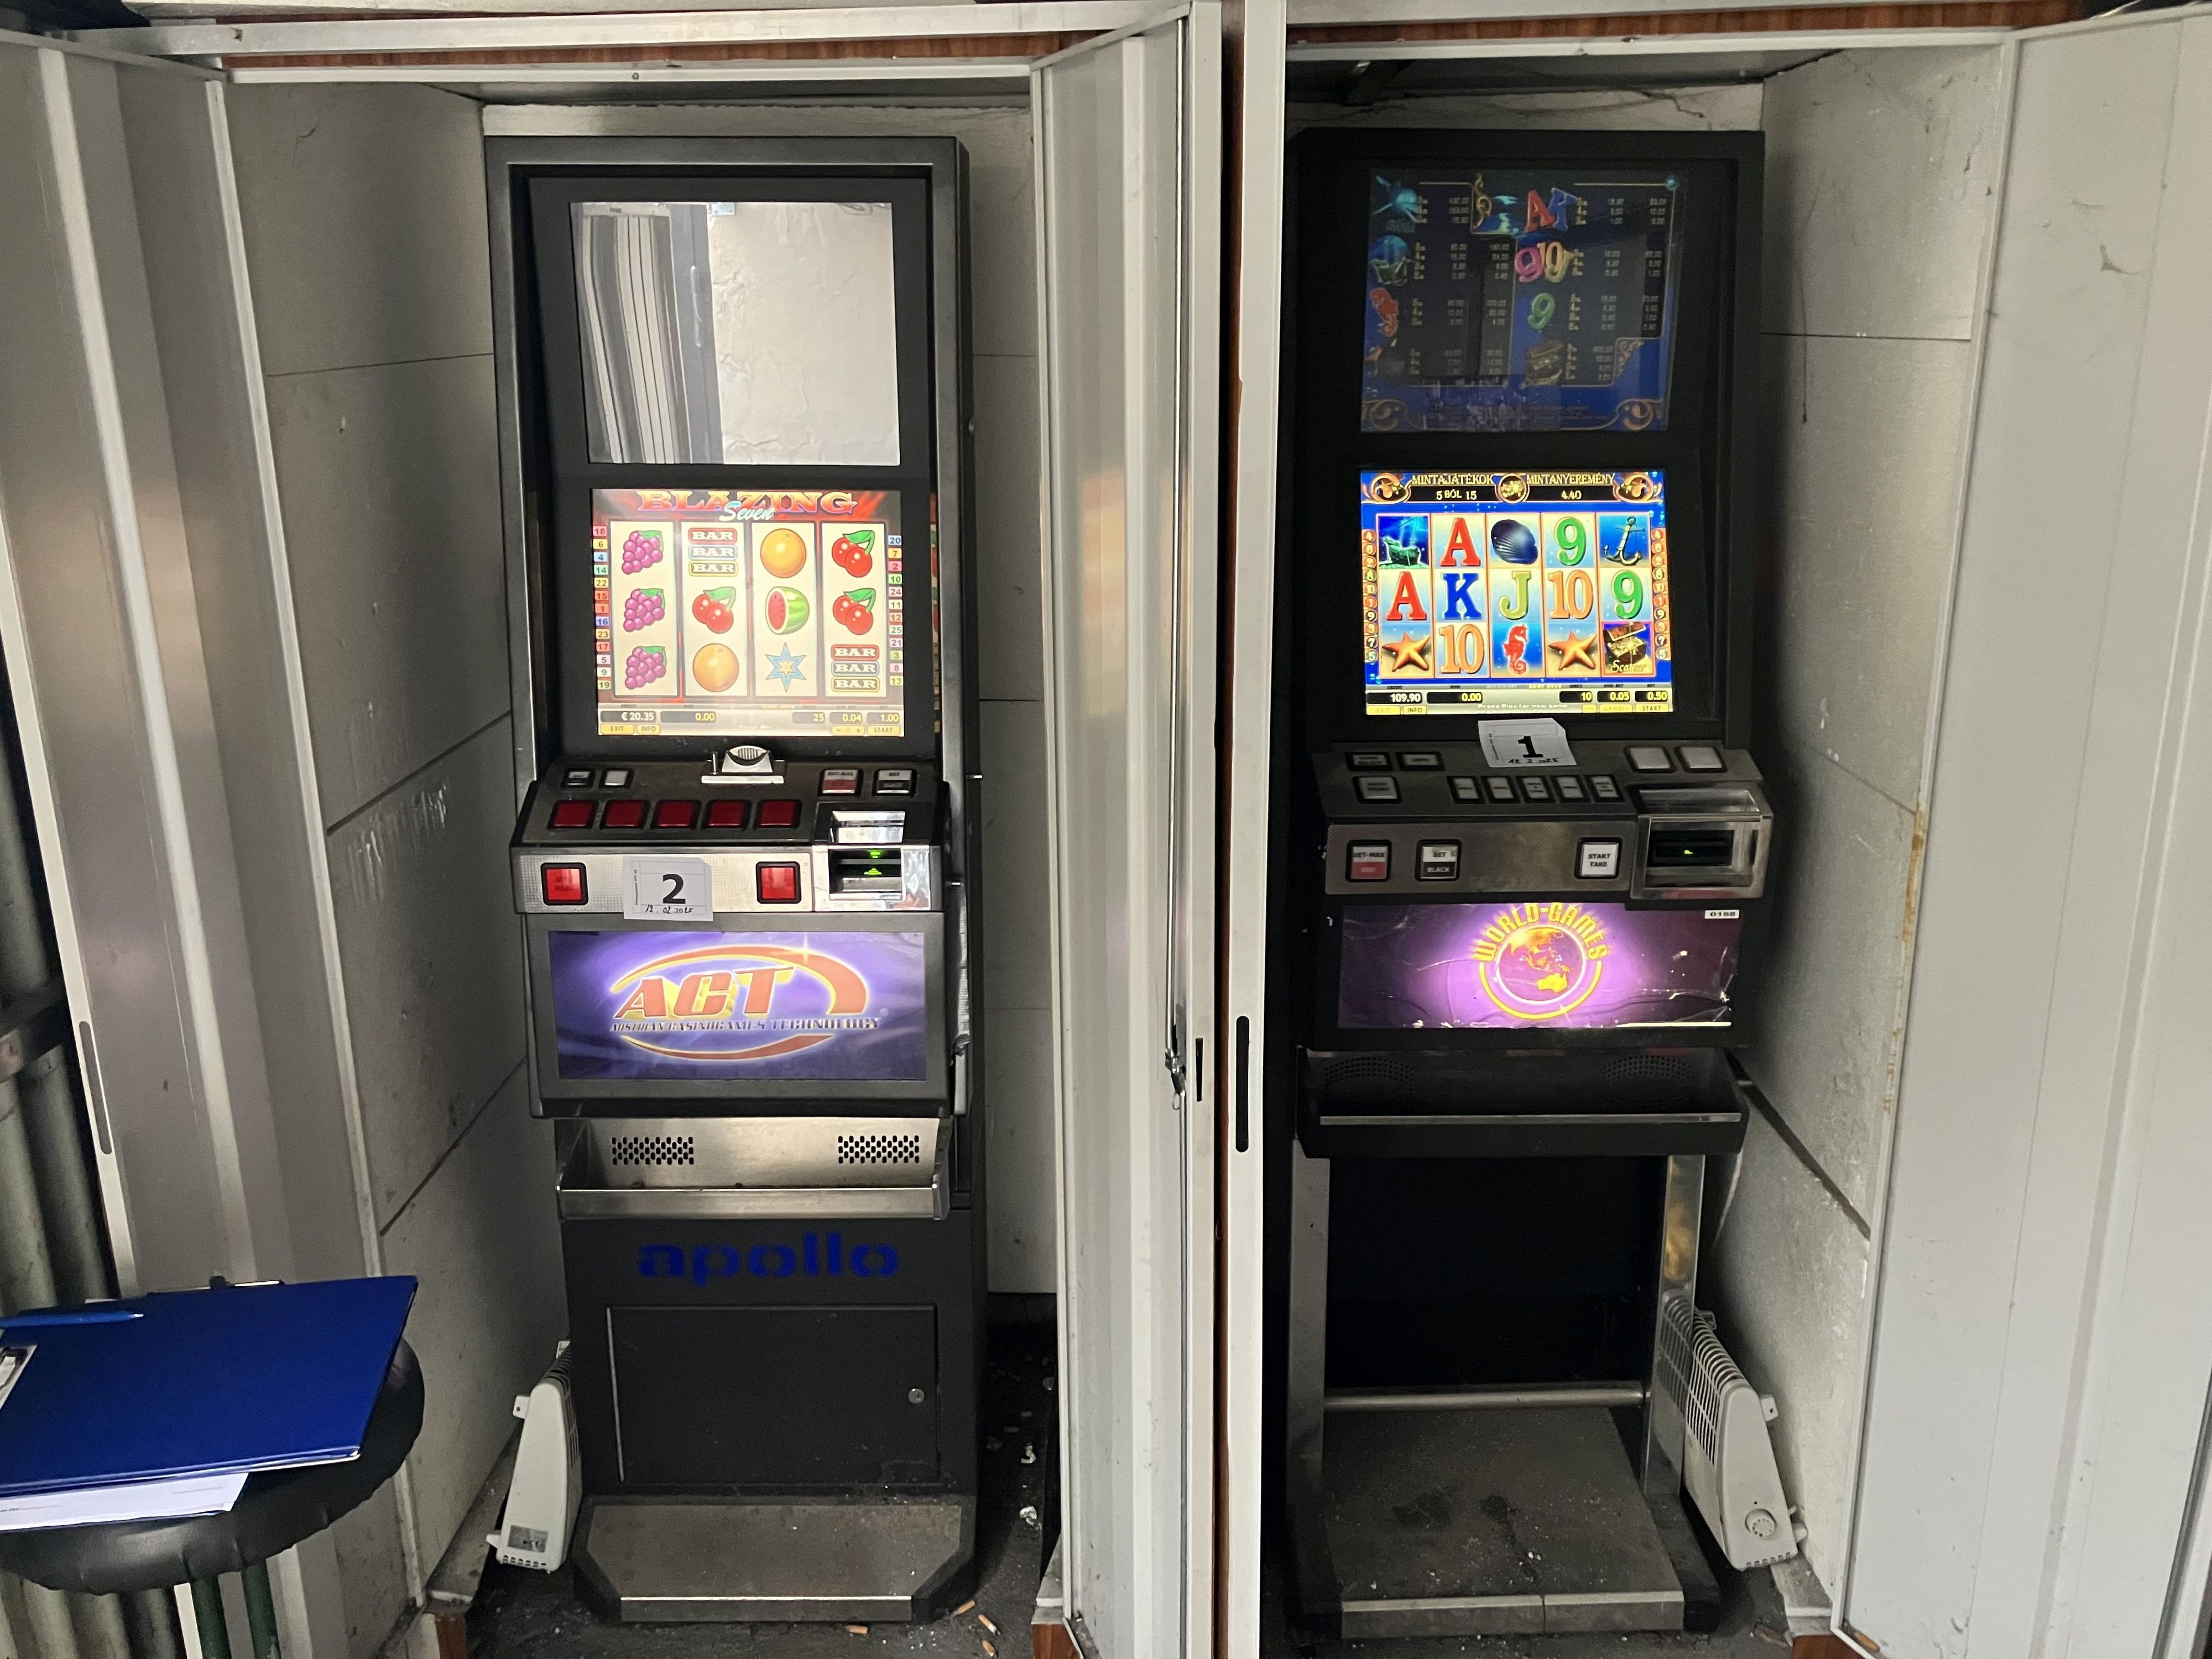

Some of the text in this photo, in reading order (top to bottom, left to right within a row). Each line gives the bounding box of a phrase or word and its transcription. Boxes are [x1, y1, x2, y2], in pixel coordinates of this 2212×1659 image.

[1527, 293, 1556, 330] 9
[1412, 473, 1494, 485] MINTAJÁTÉKOK
[1526, 473, 1616, 484] MINTANYEREMÉNY
[1436, 489, 1477, 500] 5 BÓL 15
[1561, 490, 1582, 499] 4.40
[636, 491, 858, 514] BLAZING
[719, 501, 774, 521] Seven
[691, 531, 734, 540] BAR
[1439, 517, 1481, 567] A
[1554, 517, 1586, 566] 9
[692, 547, 734, 556] BAR
[693, 564, 734, 572] BAR
[1385, 571, 1427, 620] A
[1442, 573, 1482, 620] K
[1499, 571, 1531, 620] J
[1548, 570, 1593, 619] 10
[1611, 570, 1643, 619] 9
[1368, 612, 1374, 620] 9
[1657, 610, 1663, 619] 9
[1368, 639, 1375, 647] 7
[1658, 637, 1665, 645] 7
[834, 648, 876, 657] BAR
[1439, 624, 1485, 674] 10
[1368, 652, 1375, 660] 5
[1659, 650, 1666, 659] 5
[835, 664, 876, 673] BAR
[835, 680, 877, 688] BAR
[1390, 693, 1421, 702] 109.90
[1462, 693, 1481, 702] 0.00
[1582, 692, 1592, 701] 10
[1610, 692, 1630, 701] 0.05
[1647, 692, 1667, 700] 0.50
[695, 713, 714, 721] 0.00
[842, 714, 862, 722] 0.04
[1518, 736, 1544, 758] 1
[662, 874, 686, 904] 2
[613, 966, 796, 1020] ACT
[773, 1018, 882, 1029] TECHNOLOGY
[638, 1232, 899, 1288] apollo
